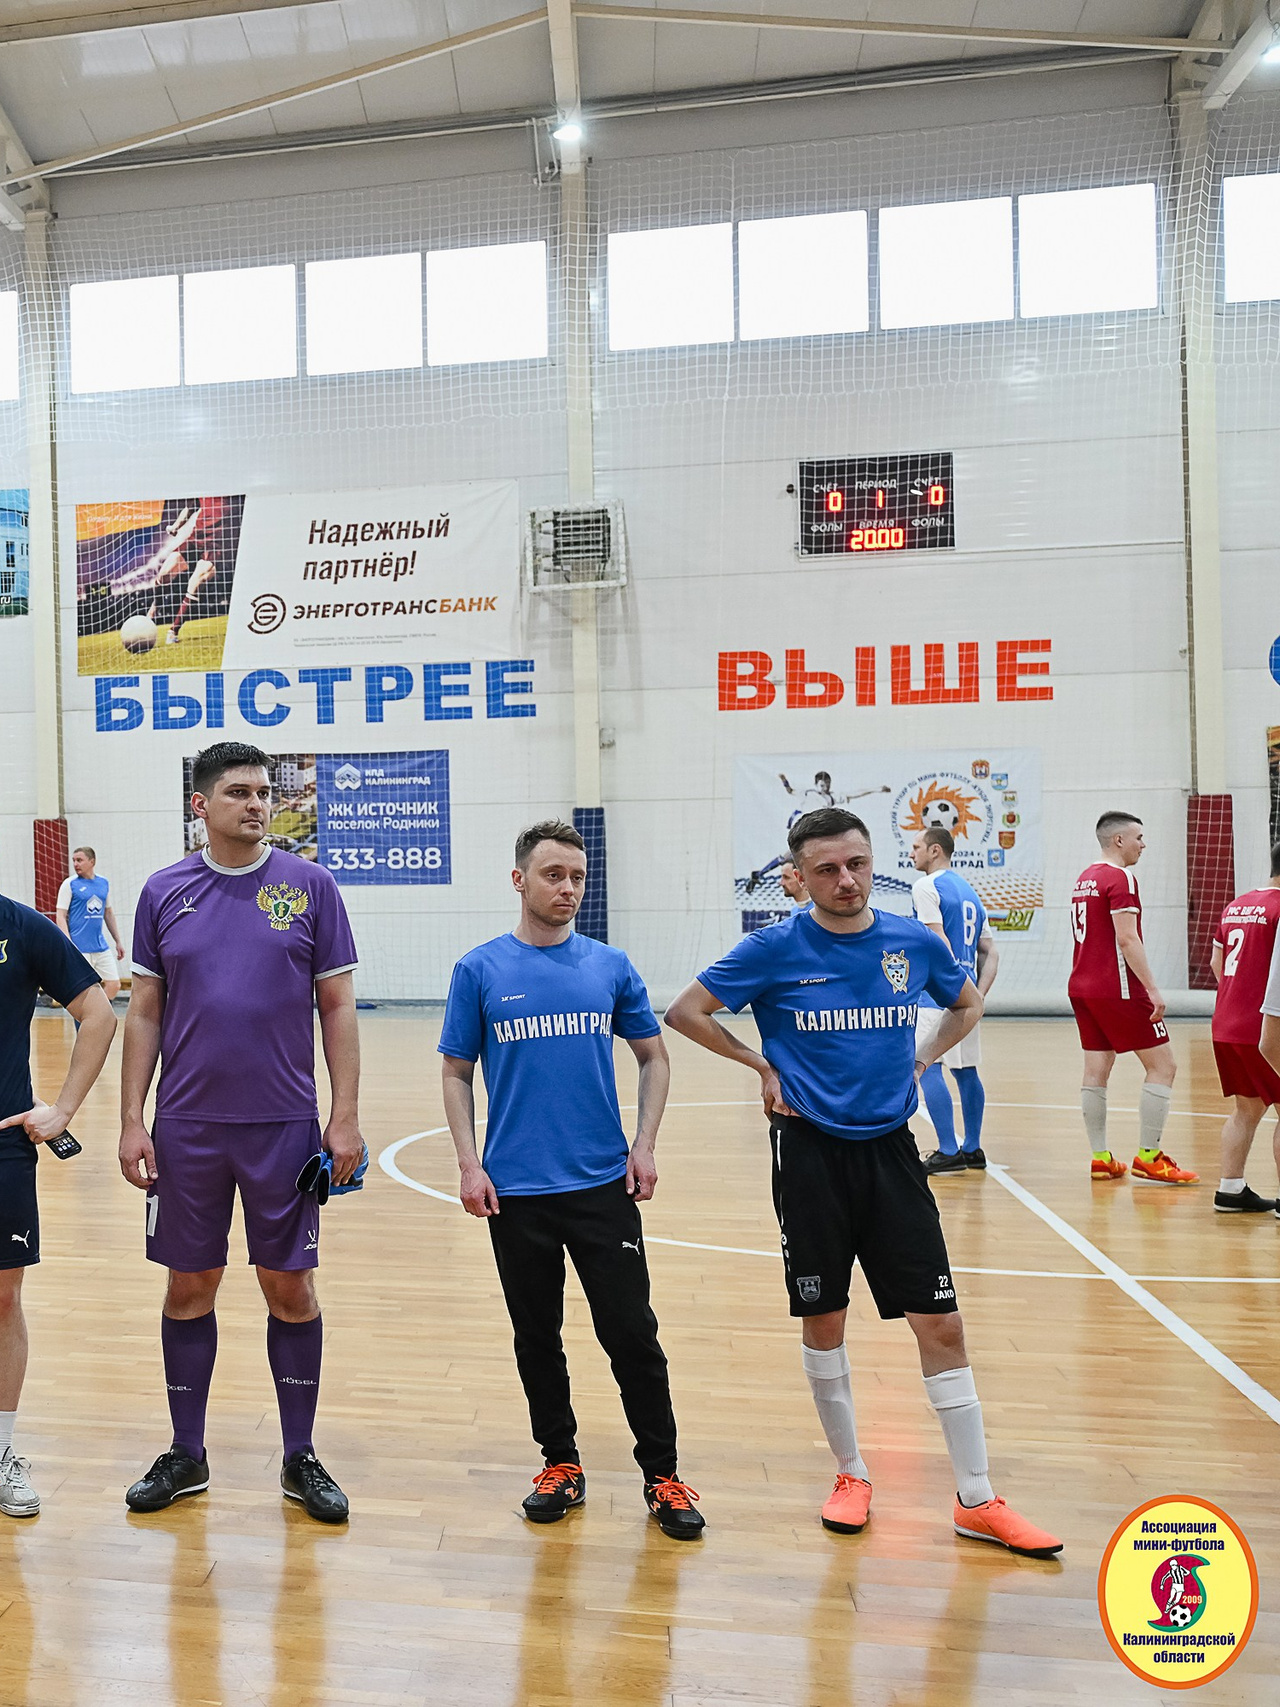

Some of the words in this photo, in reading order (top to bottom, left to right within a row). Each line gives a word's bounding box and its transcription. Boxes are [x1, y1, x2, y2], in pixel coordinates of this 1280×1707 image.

[828, 491, 842, 512] 0
[930, 485, 944, 506] 0
[308, 513, 450, 545] Надежный
[302, 550, 417, 585] партнёр!
[293, 596, 498, 620] ЭНЕРГОТРАНСБАНК
[718, 639, 1054, 711] ВЫШЕ
[94, 659, 537, 733] БЫСТРЕЕ
[328, 802, 353, 817] ЖК
[357, 801, 439, 817] ИСТОЧНИК
[327, 820, 380, 831] поселок
[383, 816, 440, 831] Родники
[327, 847, 442, 871] 333-888
[1224, 928, 1245, 977] 2
[493, 1012, 613, 1044] КАЛИНИНГРАД
[1152, 1021, 1166, 1038] 13
[938, 1275, 949, 1288] 22
[934, 1290, 955, 1300] JAKO
